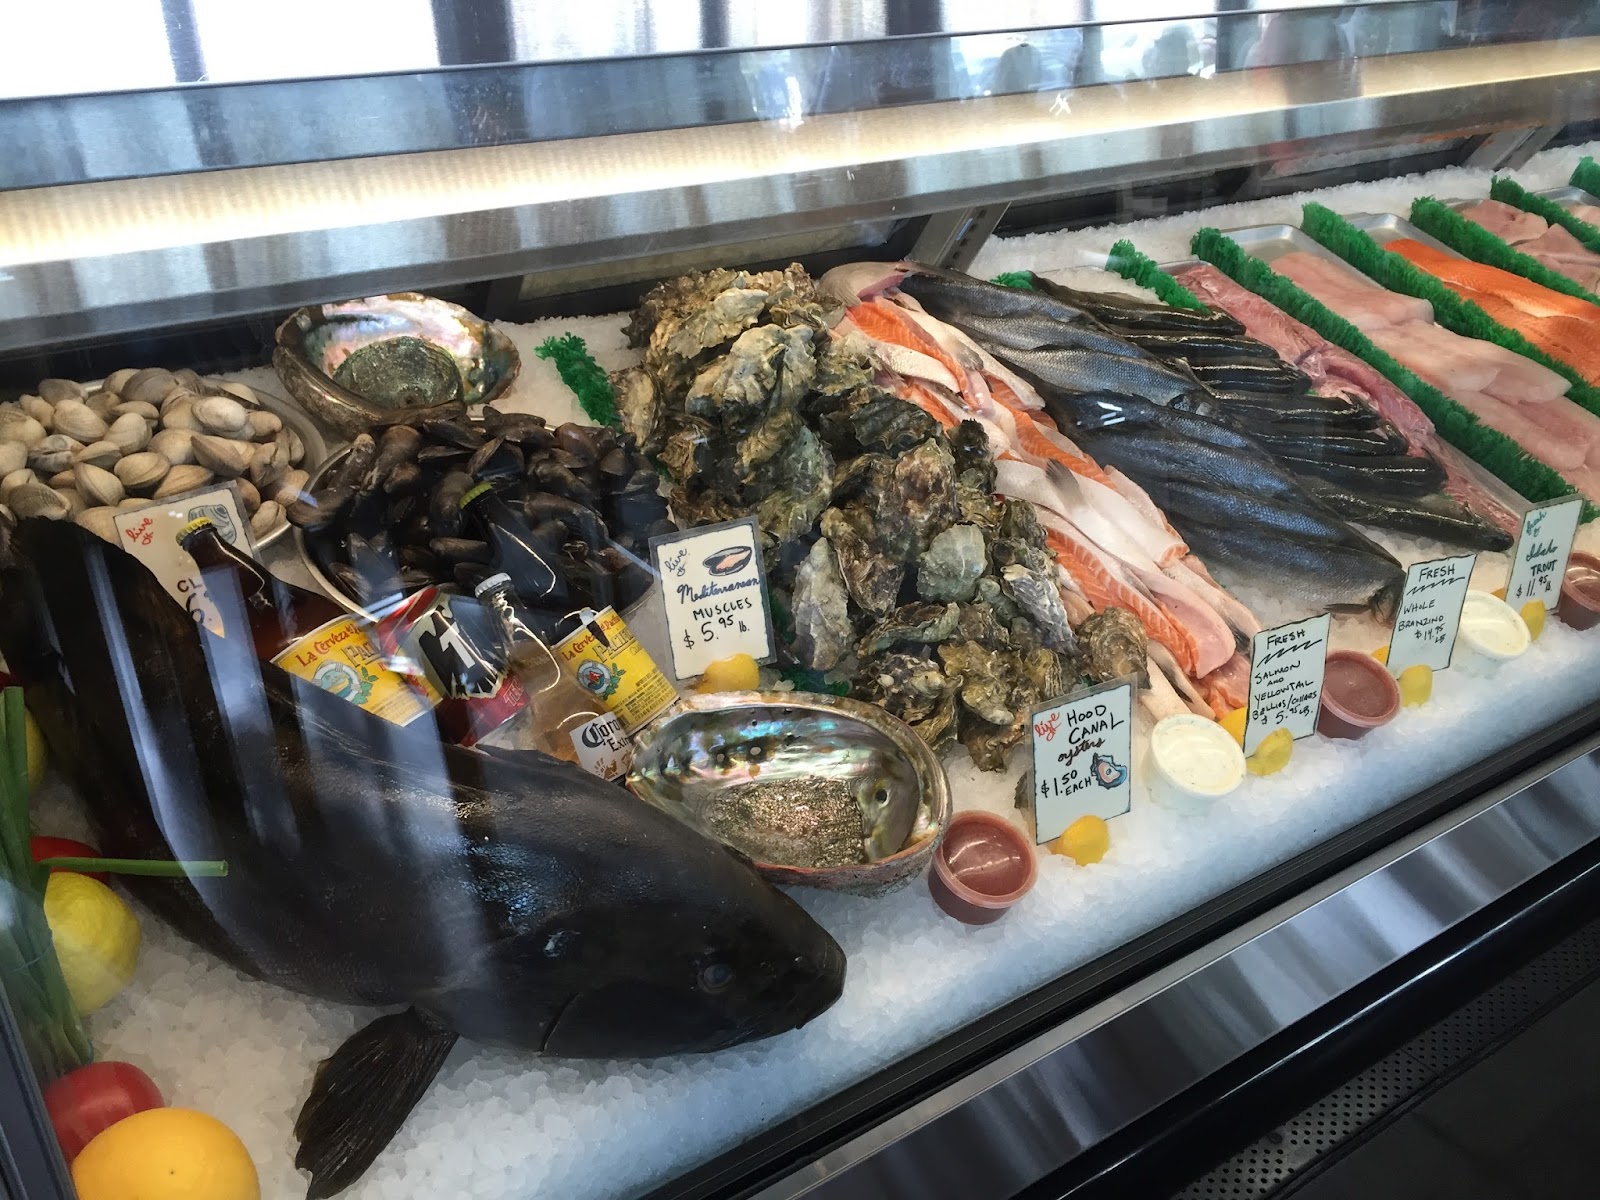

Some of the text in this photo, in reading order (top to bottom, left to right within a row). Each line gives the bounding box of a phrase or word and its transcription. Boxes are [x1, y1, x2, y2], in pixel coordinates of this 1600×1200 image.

[1418, 563, 1456, 582] FRESH
[1530, 559, 1558, 577] TROUT
[692, 597, 753, 621] MUSCLES
[1403, 598, 1436, 615] WHOLE
[1266, 628, 1306, 650] FRESH
[1255, 660, 1301, 685] SALMON
[1266, 677, 1285, 687] AND
[1254, 680, 1314, 710] YELLOWTAIL
[1066, 704, 1107, 727] HOOD
[1068, 712, 1125, 745] CANAL
[1057, 738, 1106, 767] oysters
[1065, 776, 1092, 797] EACH
